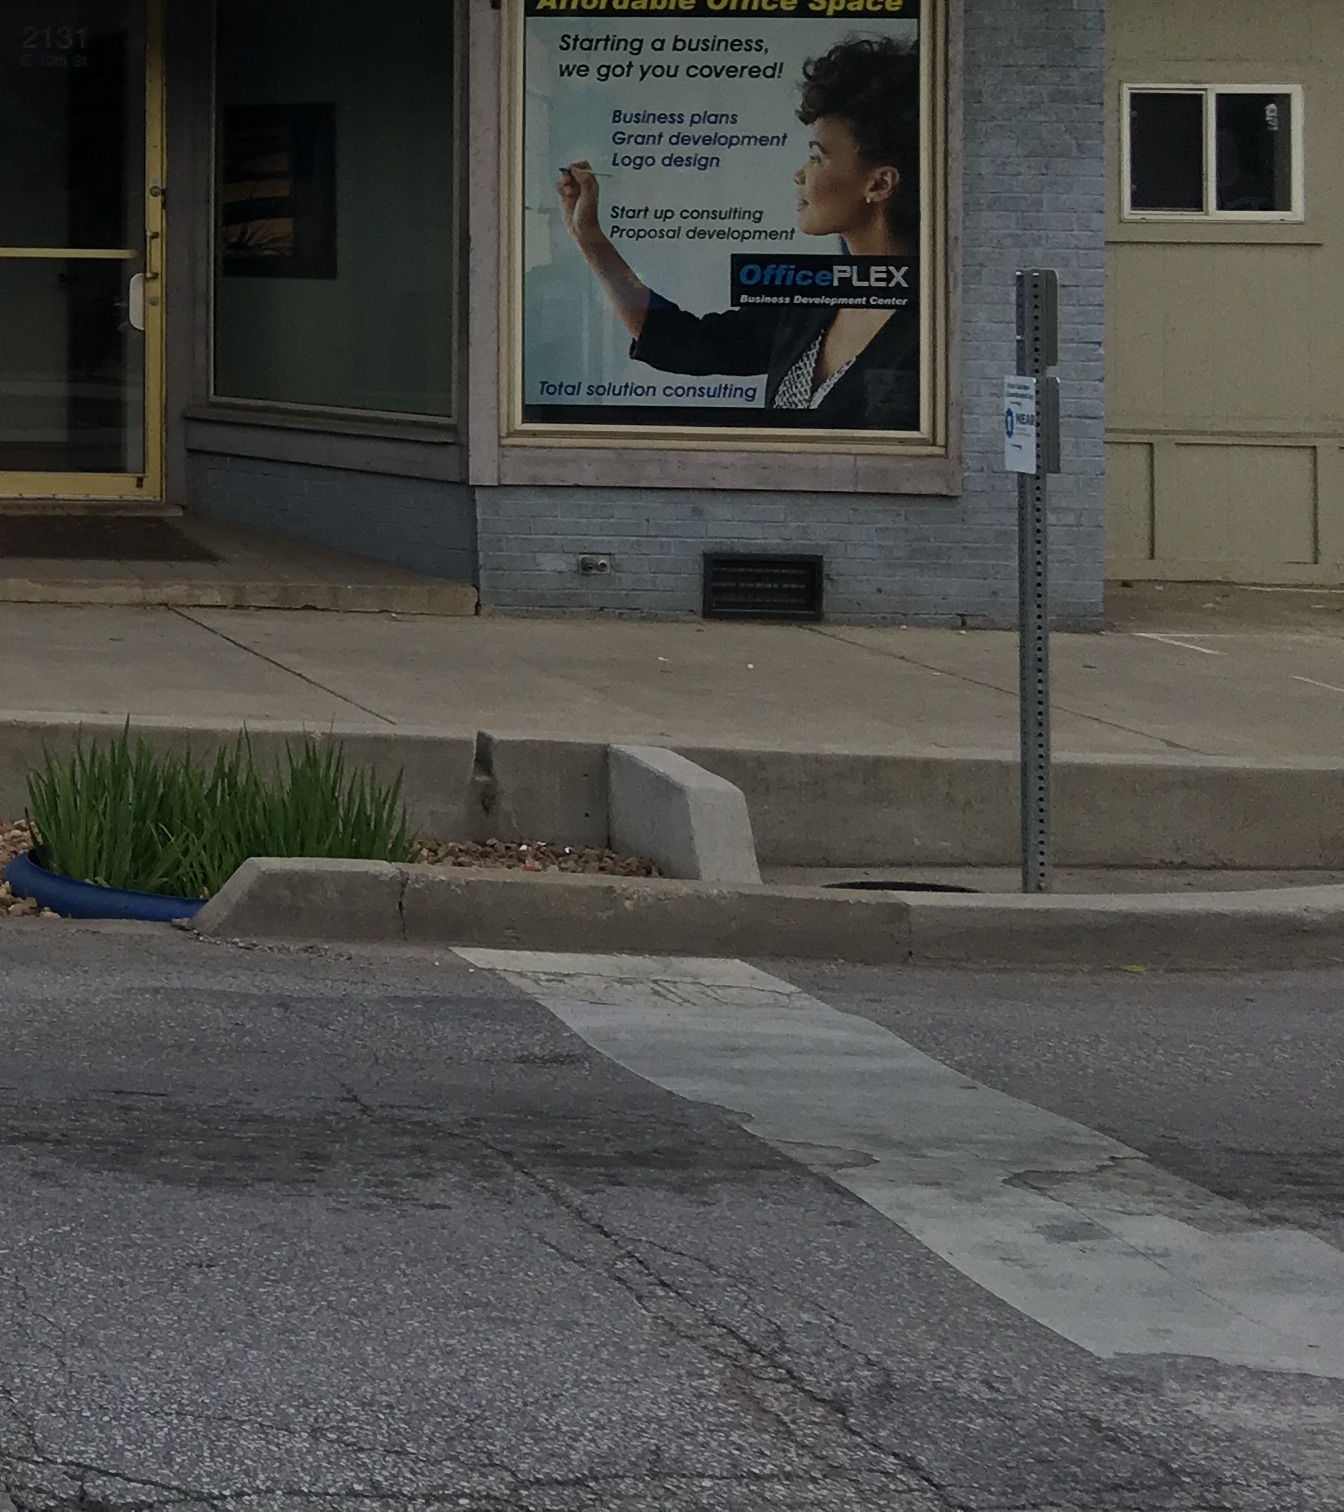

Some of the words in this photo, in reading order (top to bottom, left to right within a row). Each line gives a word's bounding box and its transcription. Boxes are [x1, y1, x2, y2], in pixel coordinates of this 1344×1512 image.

[21, 26, 90, 49] 2131
[559, 35, 644, 55] Starting
[651, 38, 665, 51] a
[672, 35, 769, 54] business,
[559, 63, 589, 77] we
[596, 61, 633, 81] got
[639, 64, 679, 81] you
[685, 62, 784, 79] covered!
[612, 110, 685, 125] Business
[689, 110, 739, 127] plans
[612, 131, 663, 146] Grant
[668, 132, 788, 149] development
[611, 153, 656, 170] Logo
[661, 153, 721, 170] design
[610, 206, 649, 219] Start
[653, 208, 675, 222] up
[679, 207, 763, 223] consulting
[609, 225, 681, 241] Proposal
[685, 226, 796, 242] development
[738, 264, 909, 287] OfficePLEX
[740, 295, 791, 304] Business
[793, 295, 866, 306] Development
[869, 296, 908, 306] Center
[539, 381, 582, 396] Total
[586, 382, 656, 397] solution
[662, 383, 757, 402] consulting
